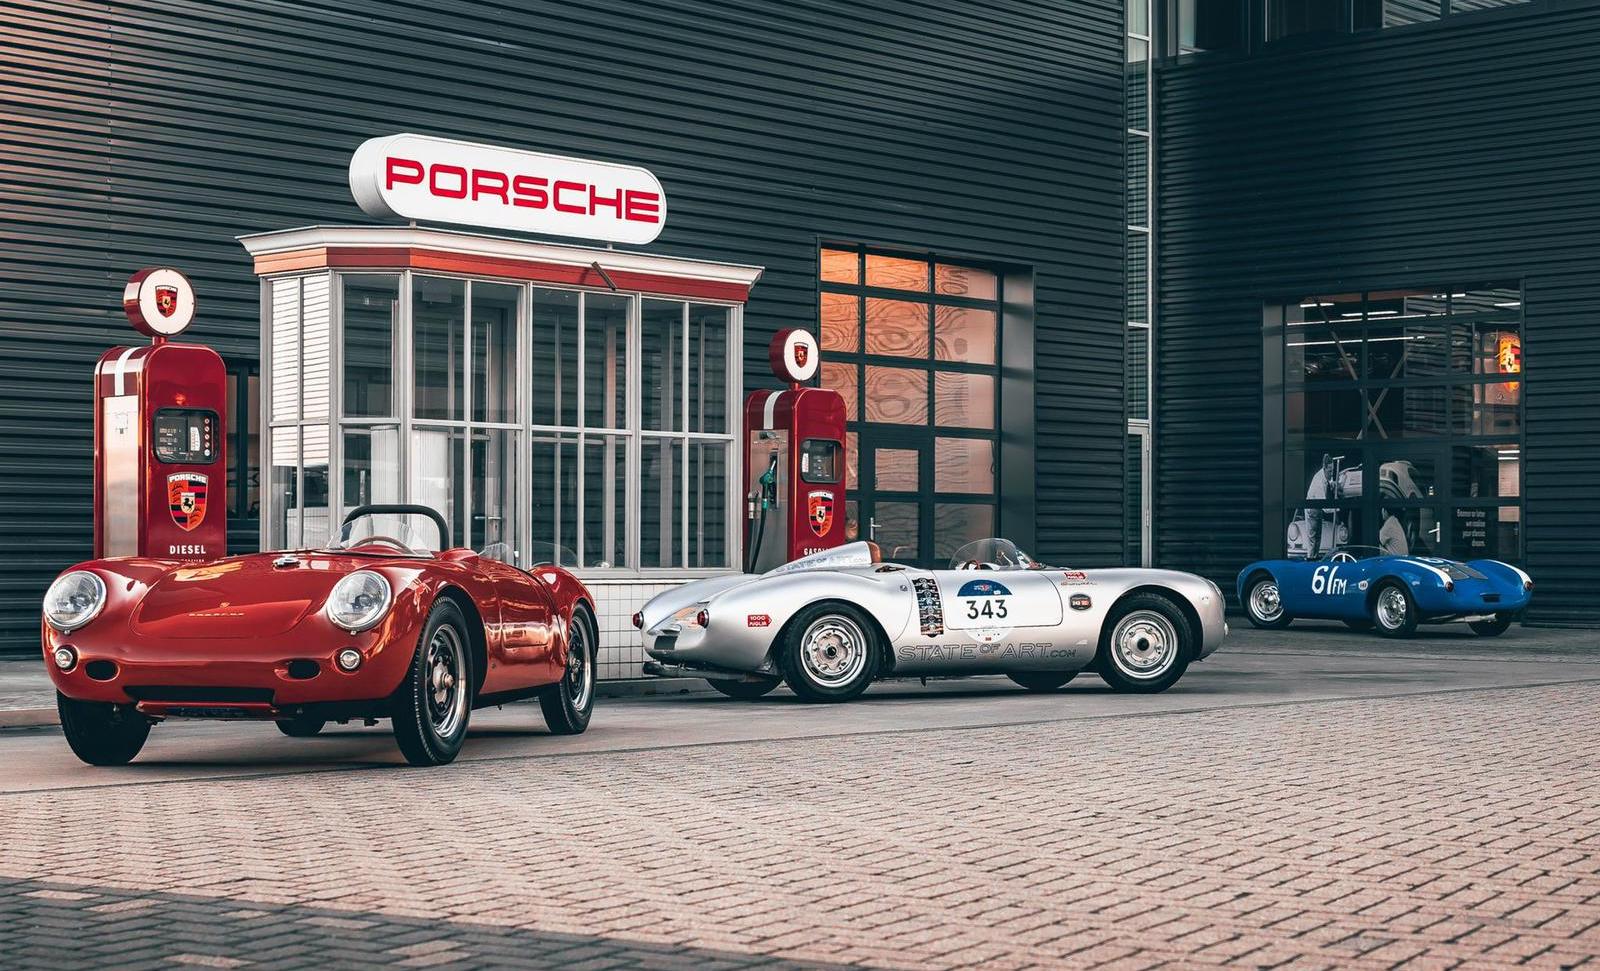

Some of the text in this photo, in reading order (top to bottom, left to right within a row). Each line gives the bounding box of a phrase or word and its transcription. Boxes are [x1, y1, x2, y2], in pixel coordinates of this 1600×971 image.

[386, 157, 659, 223] PORSCHE
[169, 473, 207, 483] PORSCHE
[169, 545, 206, 554] DIESEL
[966, 600, 1008, 619] 343
[898, 643, 977, 663] STATE
[980, 643, 1001, 654] OF
